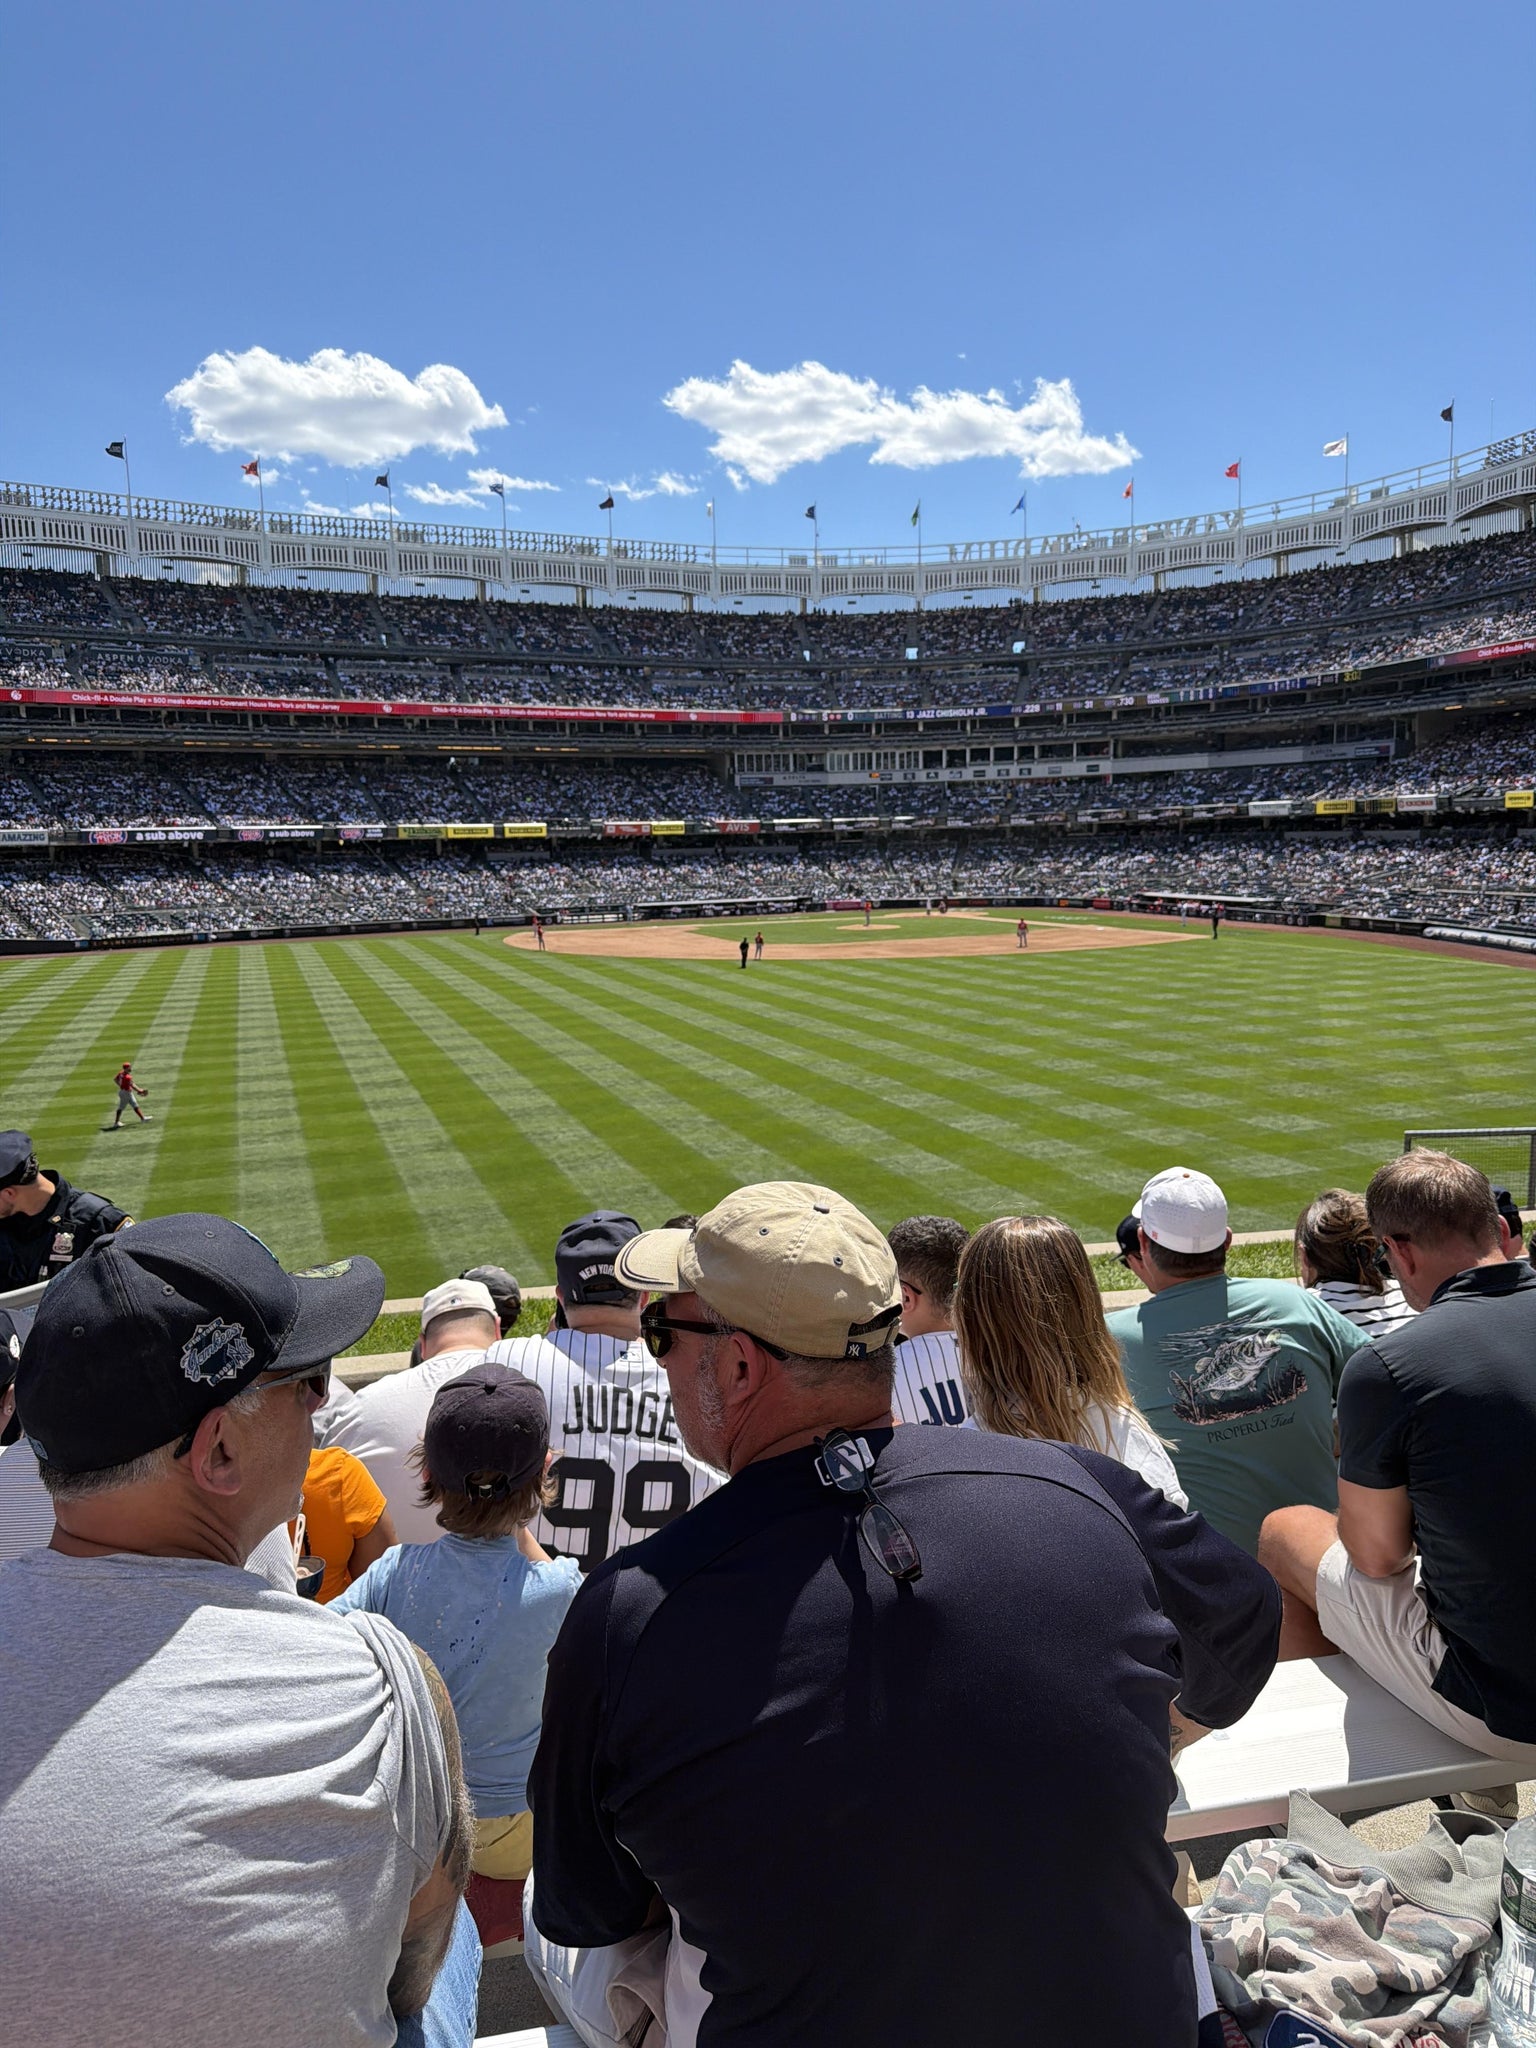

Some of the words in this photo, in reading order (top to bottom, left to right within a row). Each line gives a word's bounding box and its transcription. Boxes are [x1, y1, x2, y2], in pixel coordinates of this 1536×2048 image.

[5, 648, 46, 657] VODKA
[97, 653, 134, 662] ASPEN
[147, 656, 184, 664] VODKA
[72, 694, 108, 702] Chick-fil-A
[110, 695, 132, 703] Double
[133, 697, 146, 705] Play
[791, 713, 796, 721] B
[822, 713, 828, 721] S
[916, 710, 935, 718] JAZZ
[936, 708, 974, 718] CHISHOLM
[726, 823, 750, 832] AVIS
[2, 833, 45, 842] AMAZING
[136, 832, 144, 840] a
[145, 831, 166, 840] sub
[168, 831, 204, 840] above
[579, 1264, 598, 1280] NEW
[598, 1263, 615, 1277] YOR
[181, 1323, 242, 1382] Yankees
[919, 1379, 966, 1427] JU
[563, 1384, 678, 1445] JUDGE
[1207, 1418, 1270, 1444] PROPERLY
[1270, 1411, 1296, 1429] Tied
[540, 1456, 691, 1574] 99
